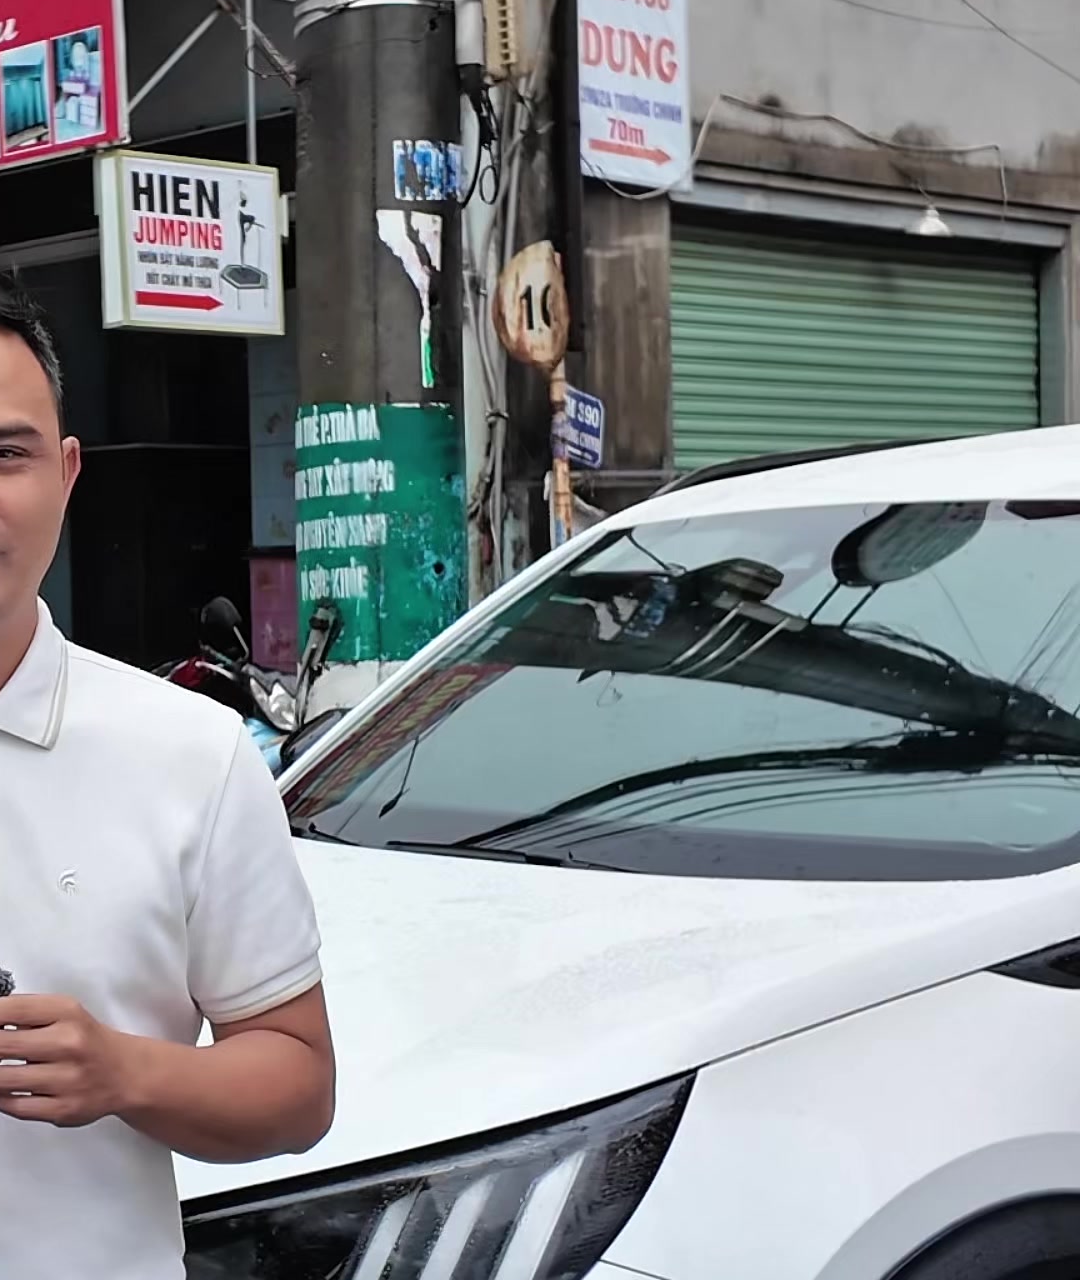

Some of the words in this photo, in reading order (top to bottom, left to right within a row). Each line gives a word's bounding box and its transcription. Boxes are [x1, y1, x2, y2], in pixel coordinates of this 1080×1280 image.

[580, 19, 677, 84] DUNG
[608, 117, 644, 146] 70m
[131, 171, 221, 219] HIEN
[133, 216, 223, 251] JUMPING
